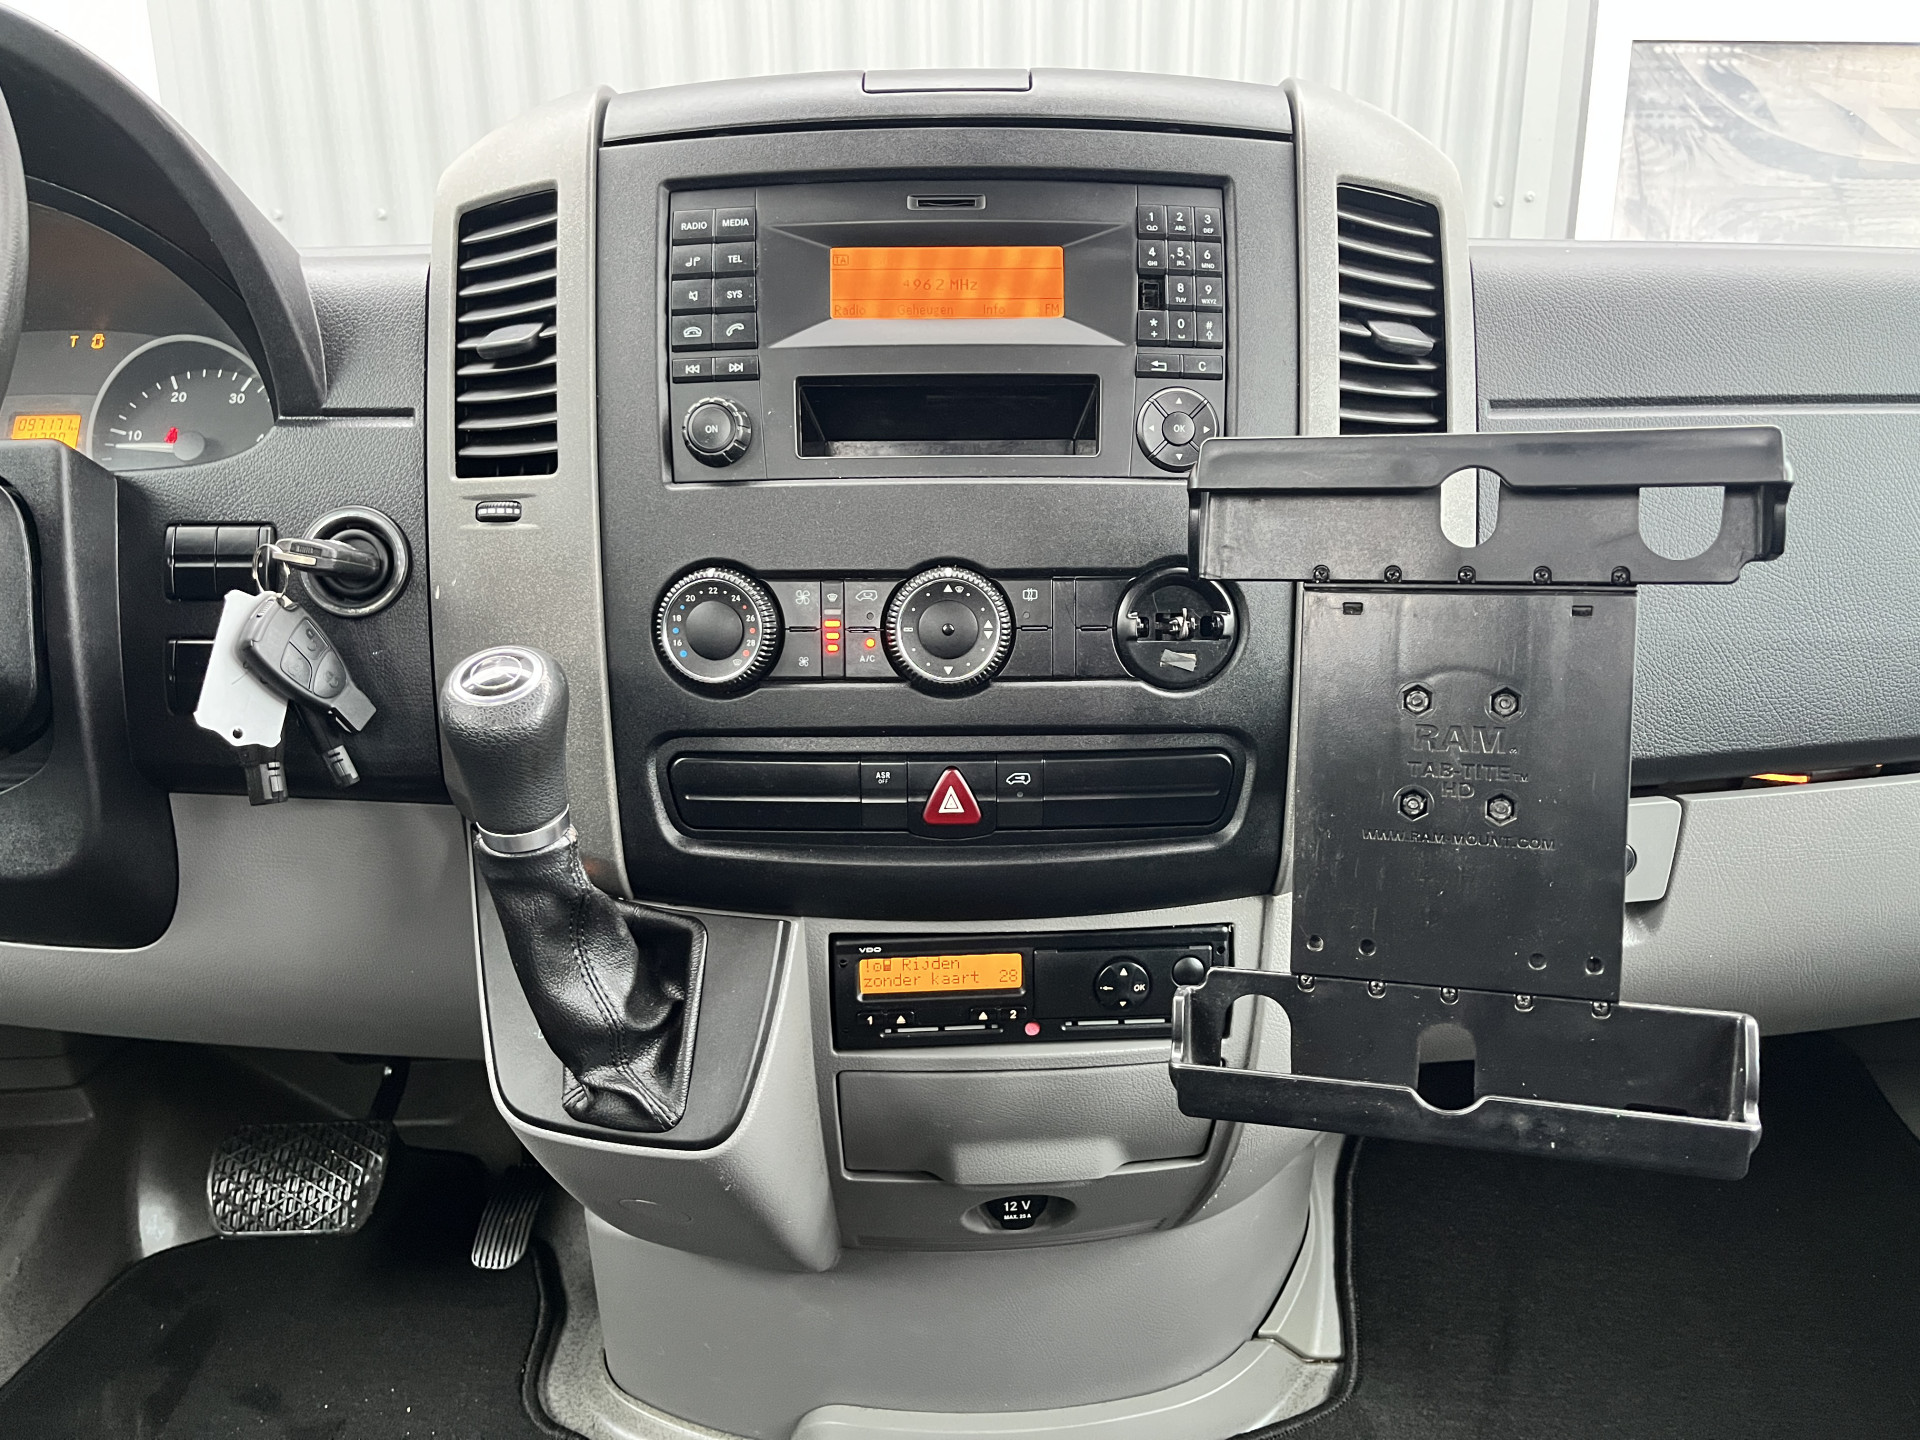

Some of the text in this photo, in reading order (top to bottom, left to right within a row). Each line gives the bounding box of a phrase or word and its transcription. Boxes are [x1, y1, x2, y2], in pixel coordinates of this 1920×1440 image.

[1148, 211, 1154, 222] 1
[1176, 211, 1184, 222] 2
[1204, 214, 1212, 224] 3
[681, 220, 708, 231] RADIO
[722, 217, 750, 228] MEDIA
[1148, 246, 1156, 257] 4
[1176, 246, 1184, 257] 5
[1203, 249, 1211, 260] 6
[727, 254, 743, 264] TEL
[835, 255, 847, 264] TA
[950, 278, 978, 291] MHz
[1176, 282, 1185, 293] 8
[1204, 284, 1212, 295] 9
[726, 289, 743, 299] SYS
[834, 303, 1060, 317] Radio Geheugen Info FM
[1177, 318, 1185, 329] 0
[1198, 361, 1207, 372] C
[170, 391, 188, 403] 20
[228, 392, 246, 404] 30
[17, 418, 73, 432] 097171
[704, 424, 719, 434] ON
[1173, 424, 1186, 433] OK
[127, 429, 143, 442] 10
[708, 587, 719, 595] 22
[685, 594, 696, 602] 20
[731, 594, 741, 602] 24
[672, 614, 682, 622] 18
[745, 614, 756, 622] 26
[672, 639, 683, 647] 16
[746, 639, 756, 647] 28
[859, 654, 876, 663] A/C
[1413, 723, 1507, 754] RAM
[875, 771, 891, 780] ASR
[1407, 761, 1511, 782] TAB-TITE
[1441, 781, 1475, 799] HD
[858, 946, 882, 954] VDO
[902, 956, 961, 973] Rijden
[863, 969, 1019, 988] zonder kaart 28
[1133, 983, 1146, 992] OK
[1009, 1009, 1017, 1020] 2
[866, 1015, 874, 1026] 1
[1003, 1200, 1031, 1212] 12 V
